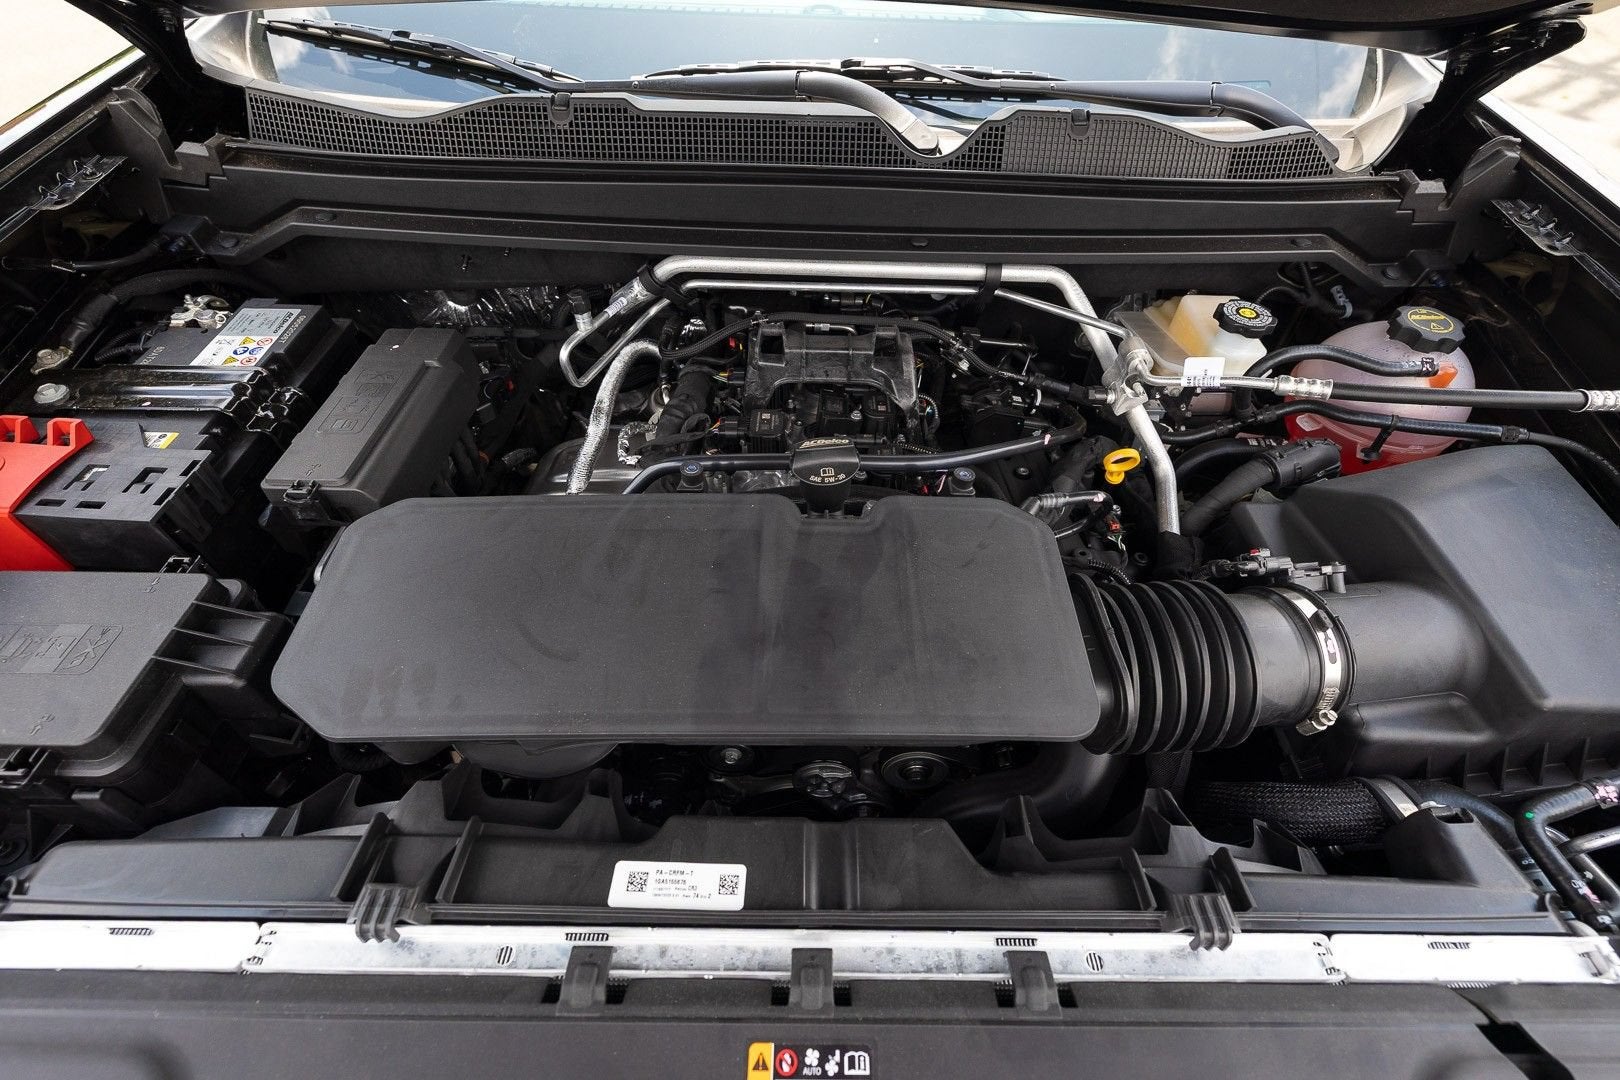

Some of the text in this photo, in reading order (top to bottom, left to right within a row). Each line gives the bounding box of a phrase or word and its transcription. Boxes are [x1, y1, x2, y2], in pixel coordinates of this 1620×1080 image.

[801, 438, 850, 448] ACDelco
[809, 473, 846, 483] SAE 5W-30
[803, 1067, 822, 1076] AUTO
